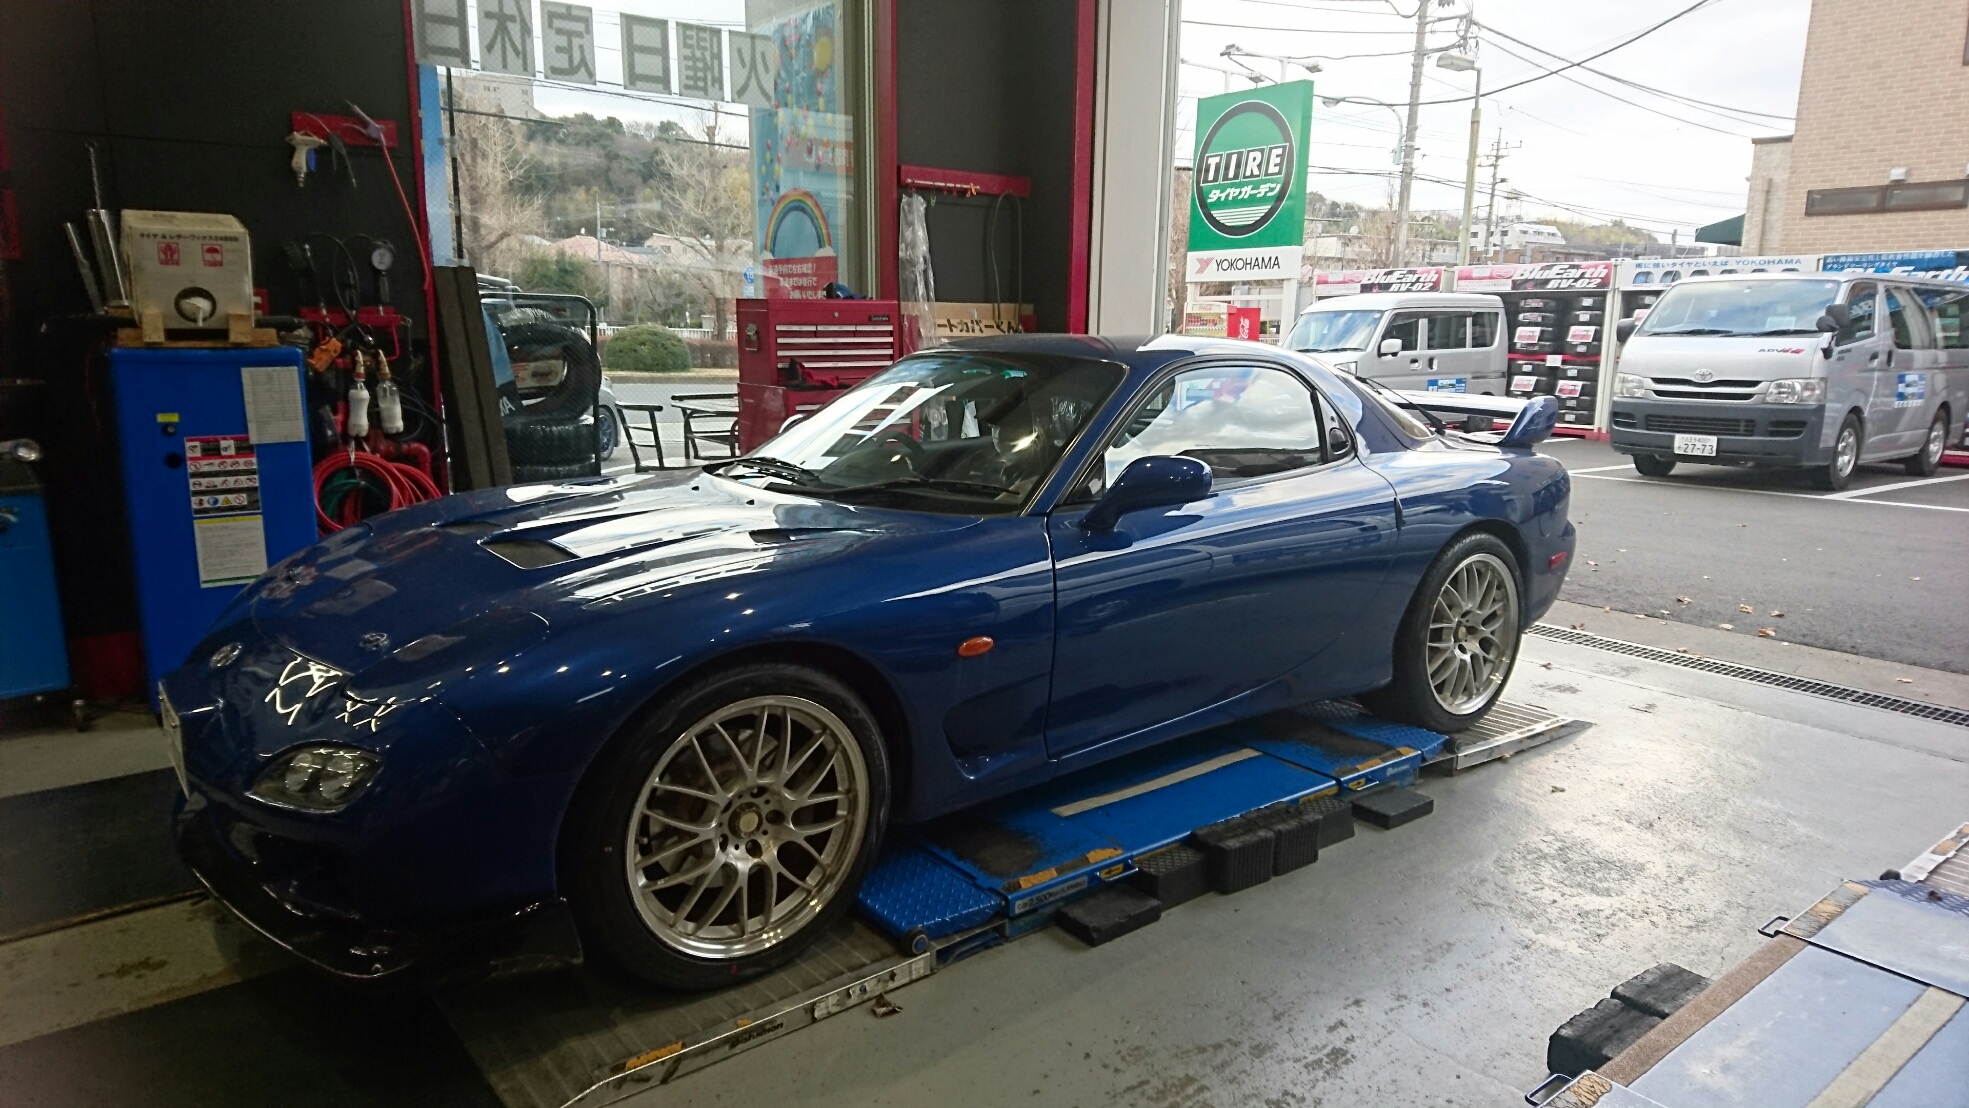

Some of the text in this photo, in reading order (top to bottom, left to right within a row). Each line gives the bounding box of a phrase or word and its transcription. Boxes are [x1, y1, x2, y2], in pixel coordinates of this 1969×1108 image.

[1207, 147, 1283, 181] TIRE
[1207, 183, 1281, 203] タイヤガーデン
[1215, 255, 1281, 272] YOKOHAMA
[1735, 257, 1802, 266] YOKOHAMA
[1361, 269, 1439, 285] BluEarth
[1511, 264, 1609, 280] BluEarth
[1388, 282, 1434, 292] RV-02
[1546, 278, 1602, 289] RV-02
[1683, 443, 1713, 454] 27-73
